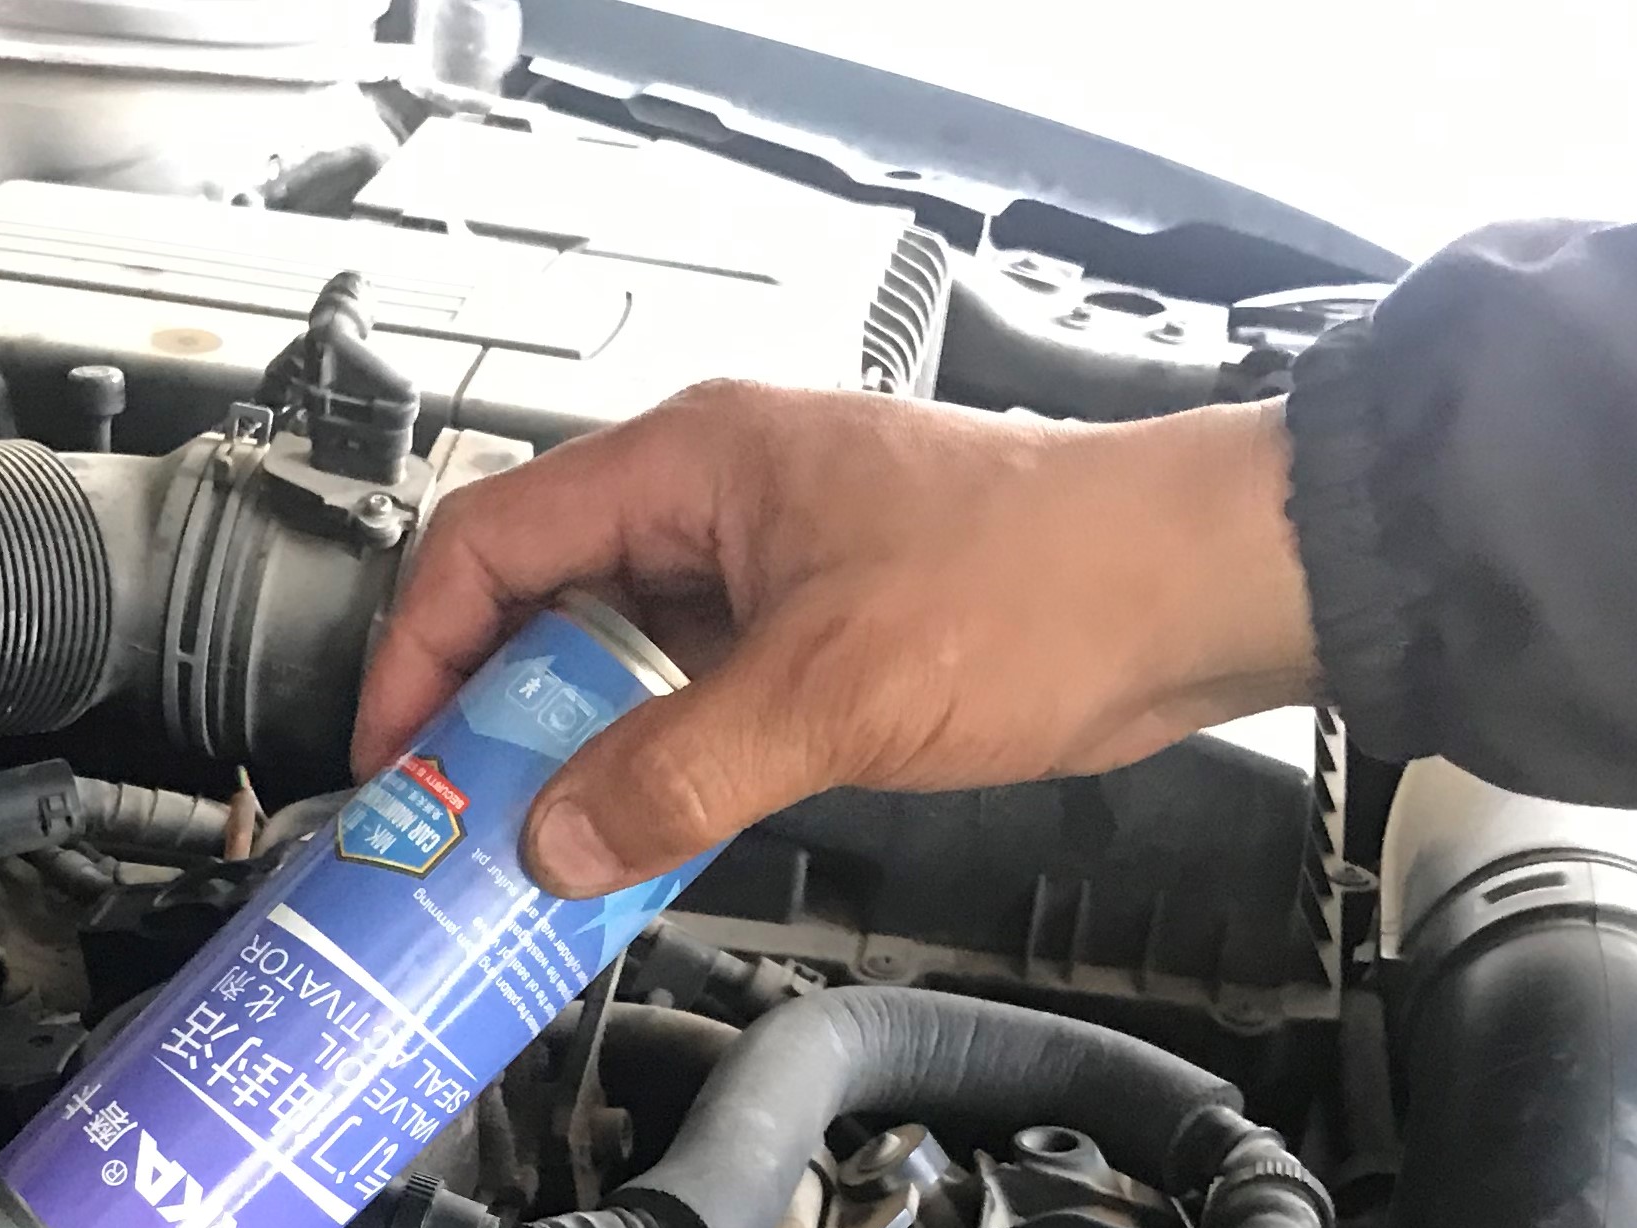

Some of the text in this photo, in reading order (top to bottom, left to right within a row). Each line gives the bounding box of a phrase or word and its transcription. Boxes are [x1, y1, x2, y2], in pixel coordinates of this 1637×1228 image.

[407, 820, 442, 854] CAR
[470, 845, 491, 866] pit
[485, 863, 519, 899] sulfur
[412, 885, 460, 936] jamming
[496, 944, 512, 960] of
[552, 938, 582, 973] cylinder
[507, 956, 531, 982] seal
[544, 965, 560, 983] the
[212, 960, 286, 1028] 化剂
[494, 976, 522, 1007] piston
[525, 978, 540, 993] oil
[534, 989, 549, 1006] the
[237, 929, 472, 1115] SEAL ACTIVATOR
[515, 1001, 529, 1020] the
[305, 1028, 441, 1146] VALVE OIL
